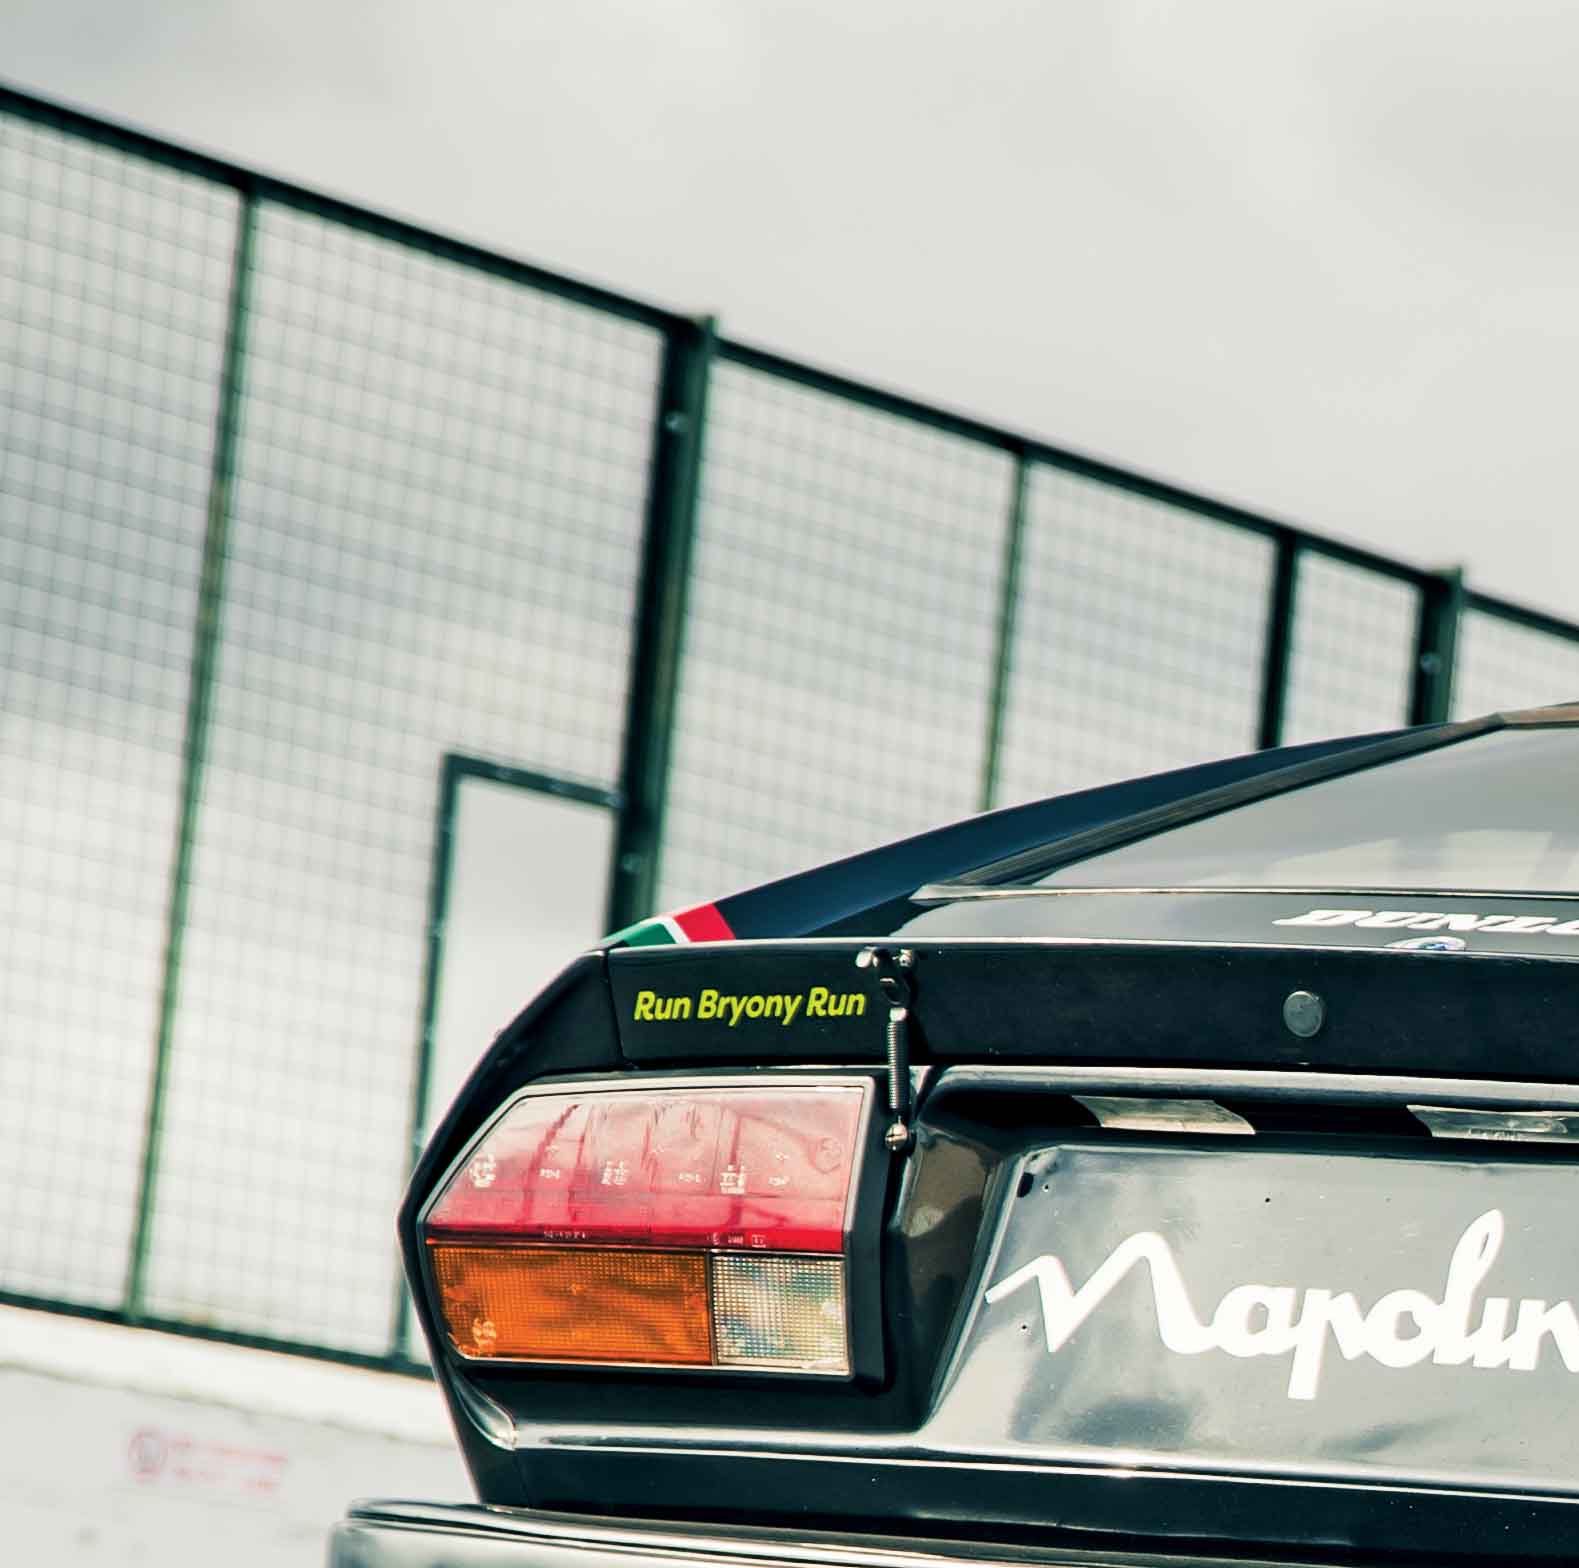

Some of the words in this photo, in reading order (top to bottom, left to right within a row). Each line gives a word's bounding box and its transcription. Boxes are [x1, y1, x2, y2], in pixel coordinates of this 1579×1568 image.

[634, 989, 691, 1021] Run
[696, 988, 803, 1027] Bryony
[806, 985, 866, 1018] Run
